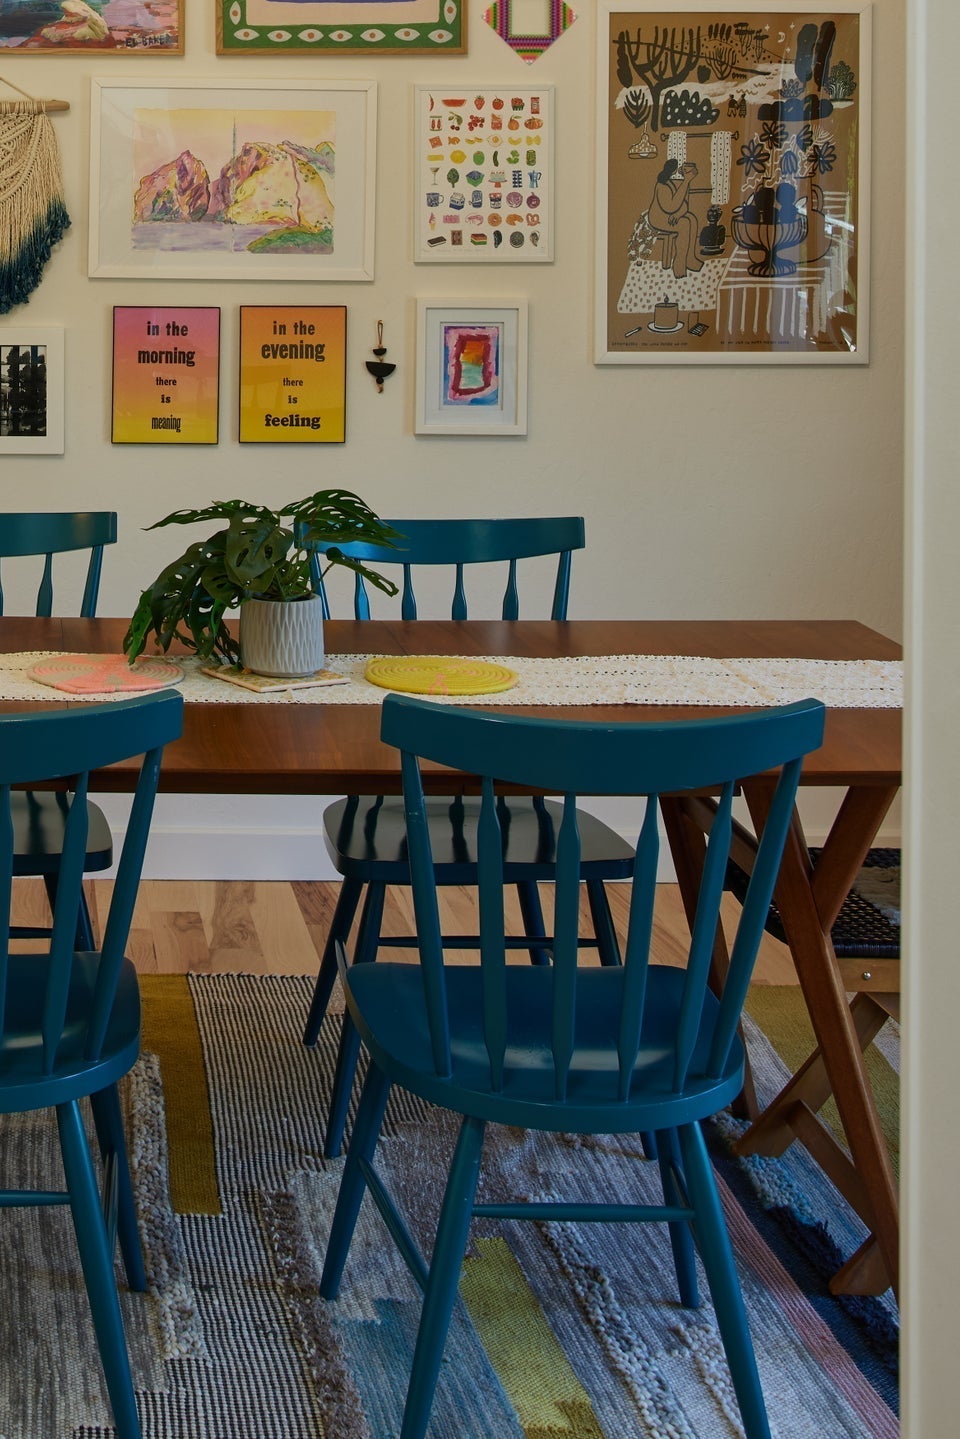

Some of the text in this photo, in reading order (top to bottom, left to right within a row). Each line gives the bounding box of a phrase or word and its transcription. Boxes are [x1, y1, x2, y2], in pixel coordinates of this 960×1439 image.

[146, 321, 189, 336] in the
[273, 320, 315, 335] in the
[137, 347, 196, 367] morning
[261, 340, 325, 362] evening
[155, 377, 177, 386] there
[282, 377, 304, 387] there
[160, 394, 171, 403] is
[287, 395, 298, 404] is
[151, 414, 181, 433] meaning
[264, 414, 321, 430] feeling
